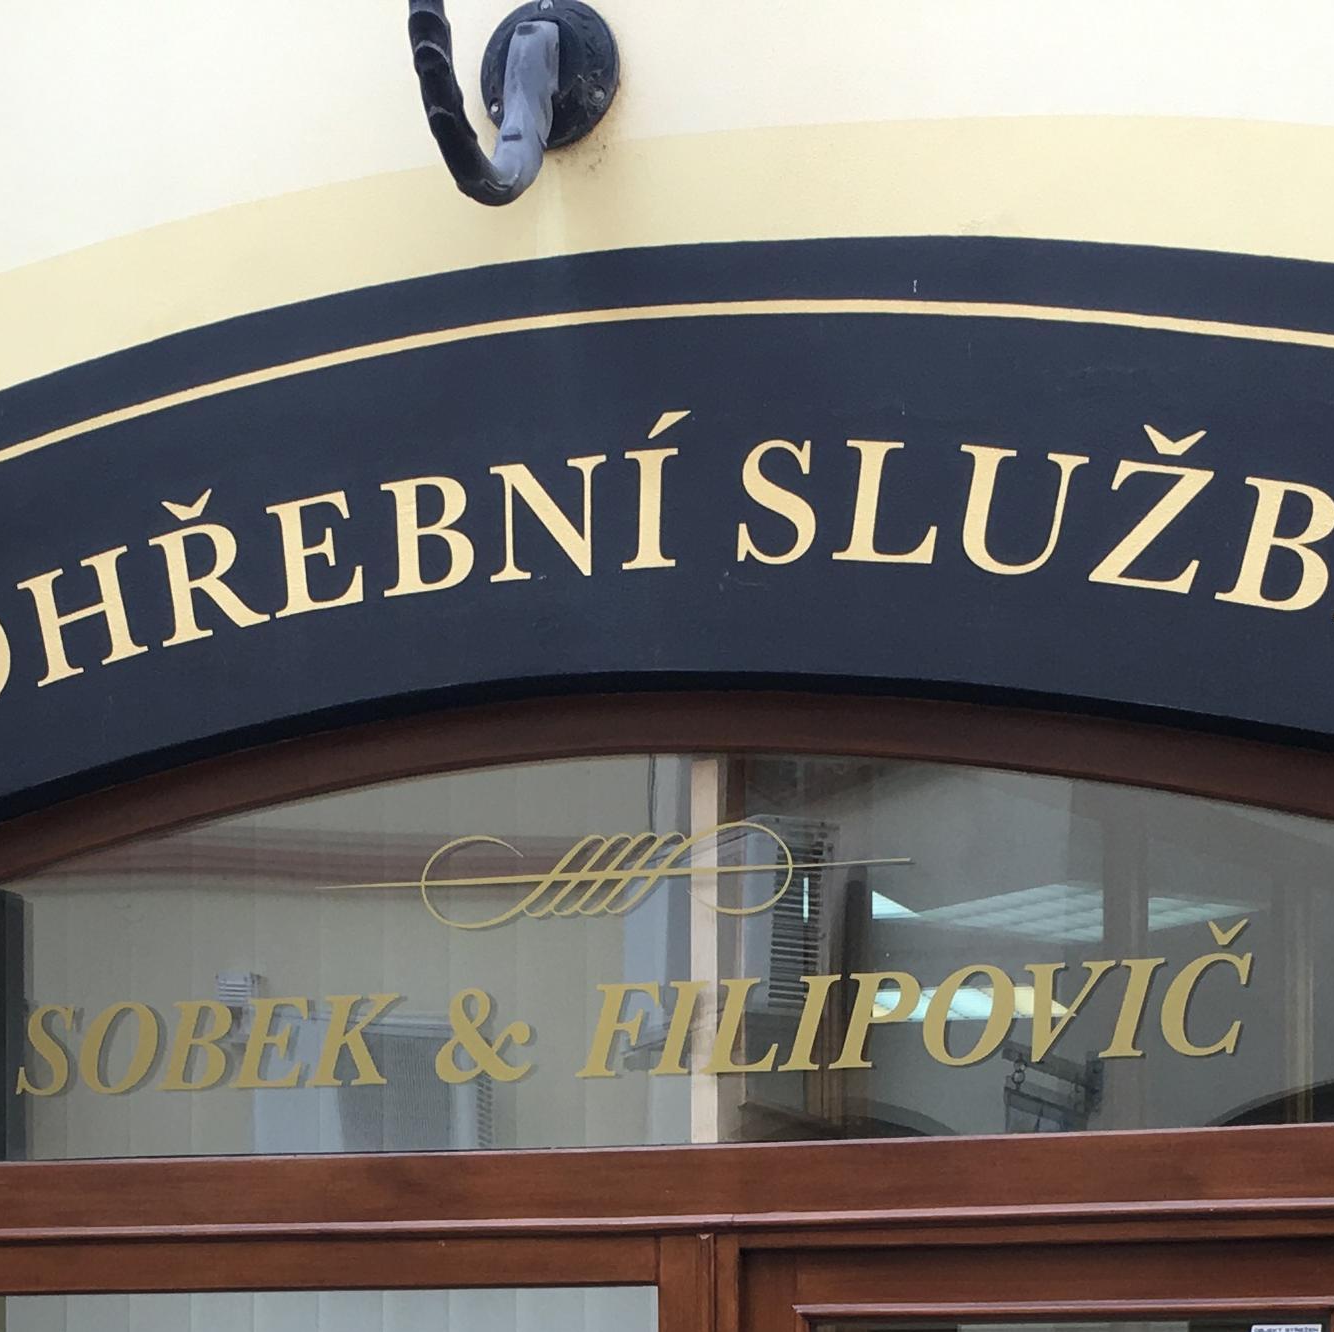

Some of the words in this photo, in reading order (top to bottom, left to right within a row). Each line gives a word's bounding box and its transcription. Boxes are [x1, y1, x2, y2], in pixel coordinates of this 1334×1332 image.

[15, 991, 397, 1098] SOBEK
[434, 986, 535, 1086] &
[576, 917, 1255, 1081] FILIPOVIČ
